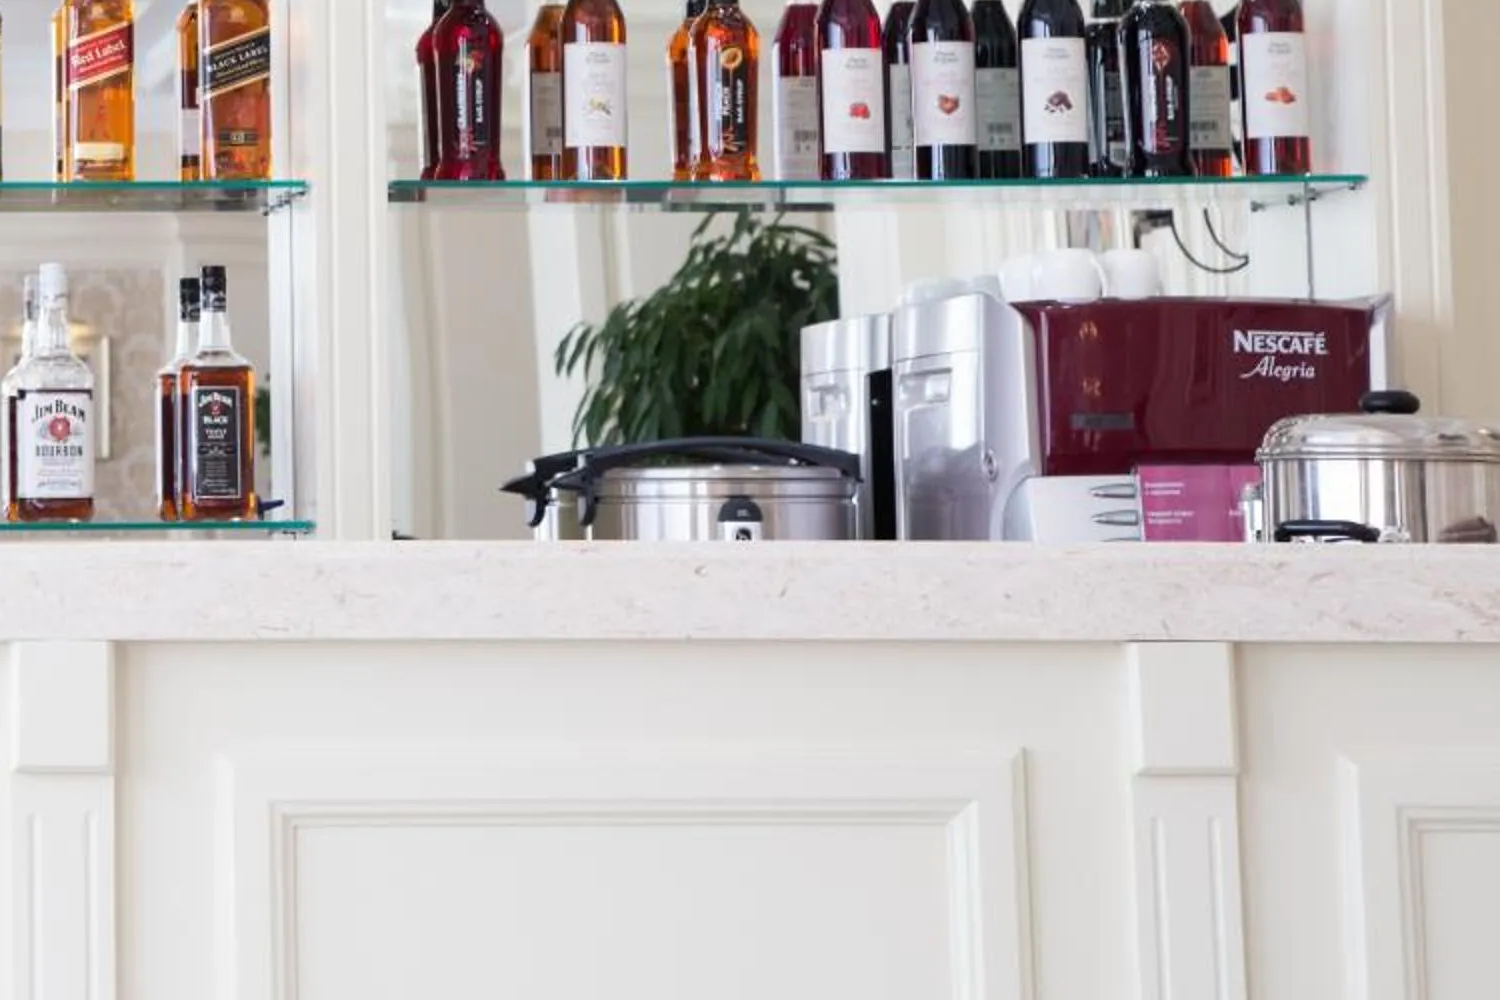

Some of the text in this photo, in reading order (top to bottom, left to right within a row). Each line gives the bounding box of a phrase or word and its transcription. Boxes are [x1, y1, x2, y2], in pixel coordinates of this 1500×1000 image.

[95, 40, 127, 59] Label
[239, 46, 269, 62] LABEL
[1233, 329, 1329, 355] NESCAFÉ
[1239, 355, 1316, 382] Alegria
[32, 399, 86, 424] JIM BEAM
[35, 445, 84, 457] BOURBON
